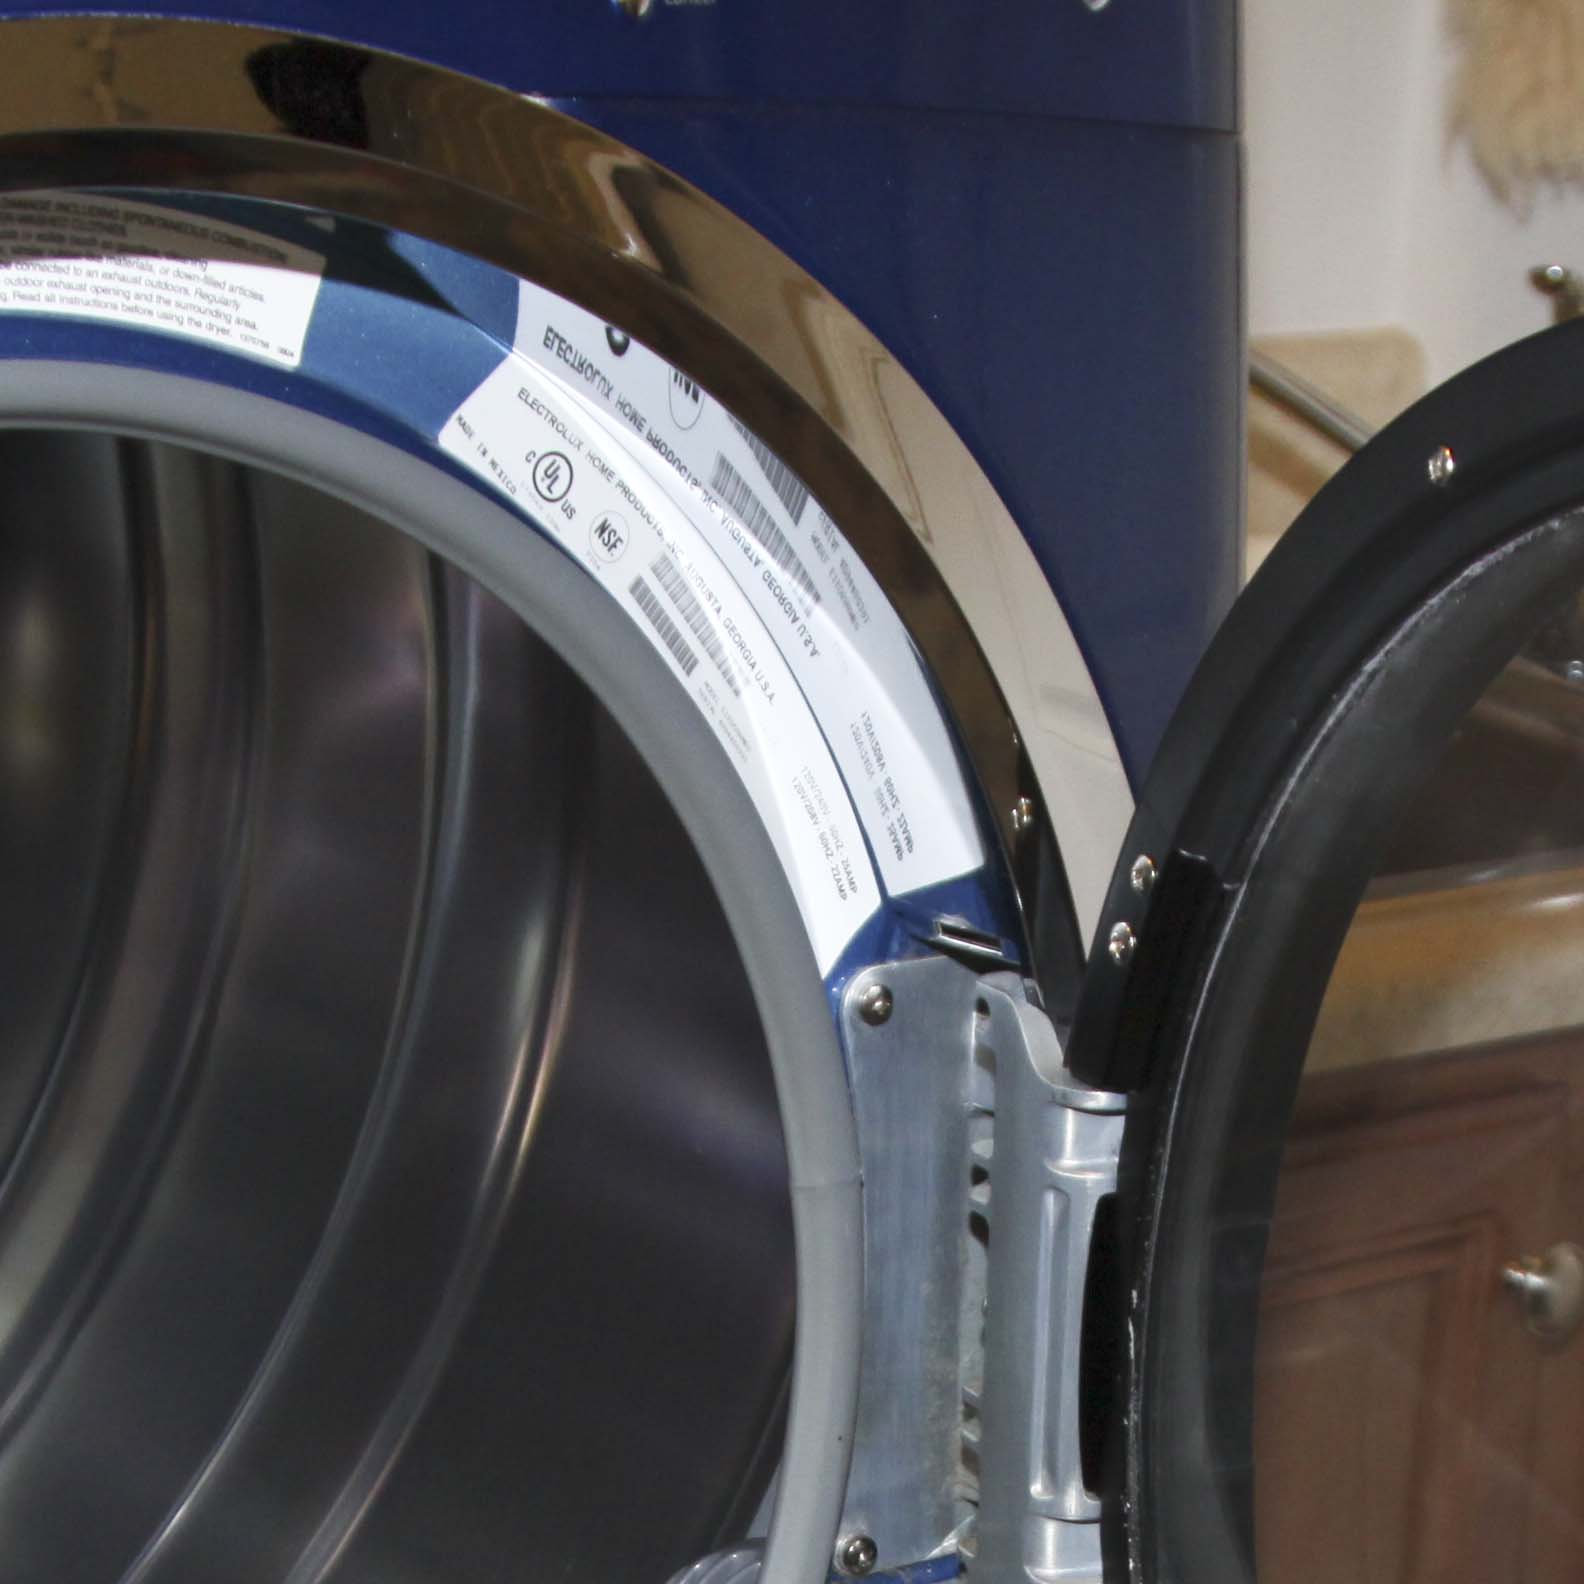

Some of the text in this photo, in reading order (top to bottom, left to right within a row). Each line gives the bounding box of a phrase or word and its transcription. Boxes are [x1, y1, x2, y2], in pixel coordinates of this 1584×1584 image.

[517, 386, 585, 451] ELECTROLUX
[586, 448, 618, 484] HOME
[560, 499, 577, 520] US
[593, 517, 624, 556] NSF
